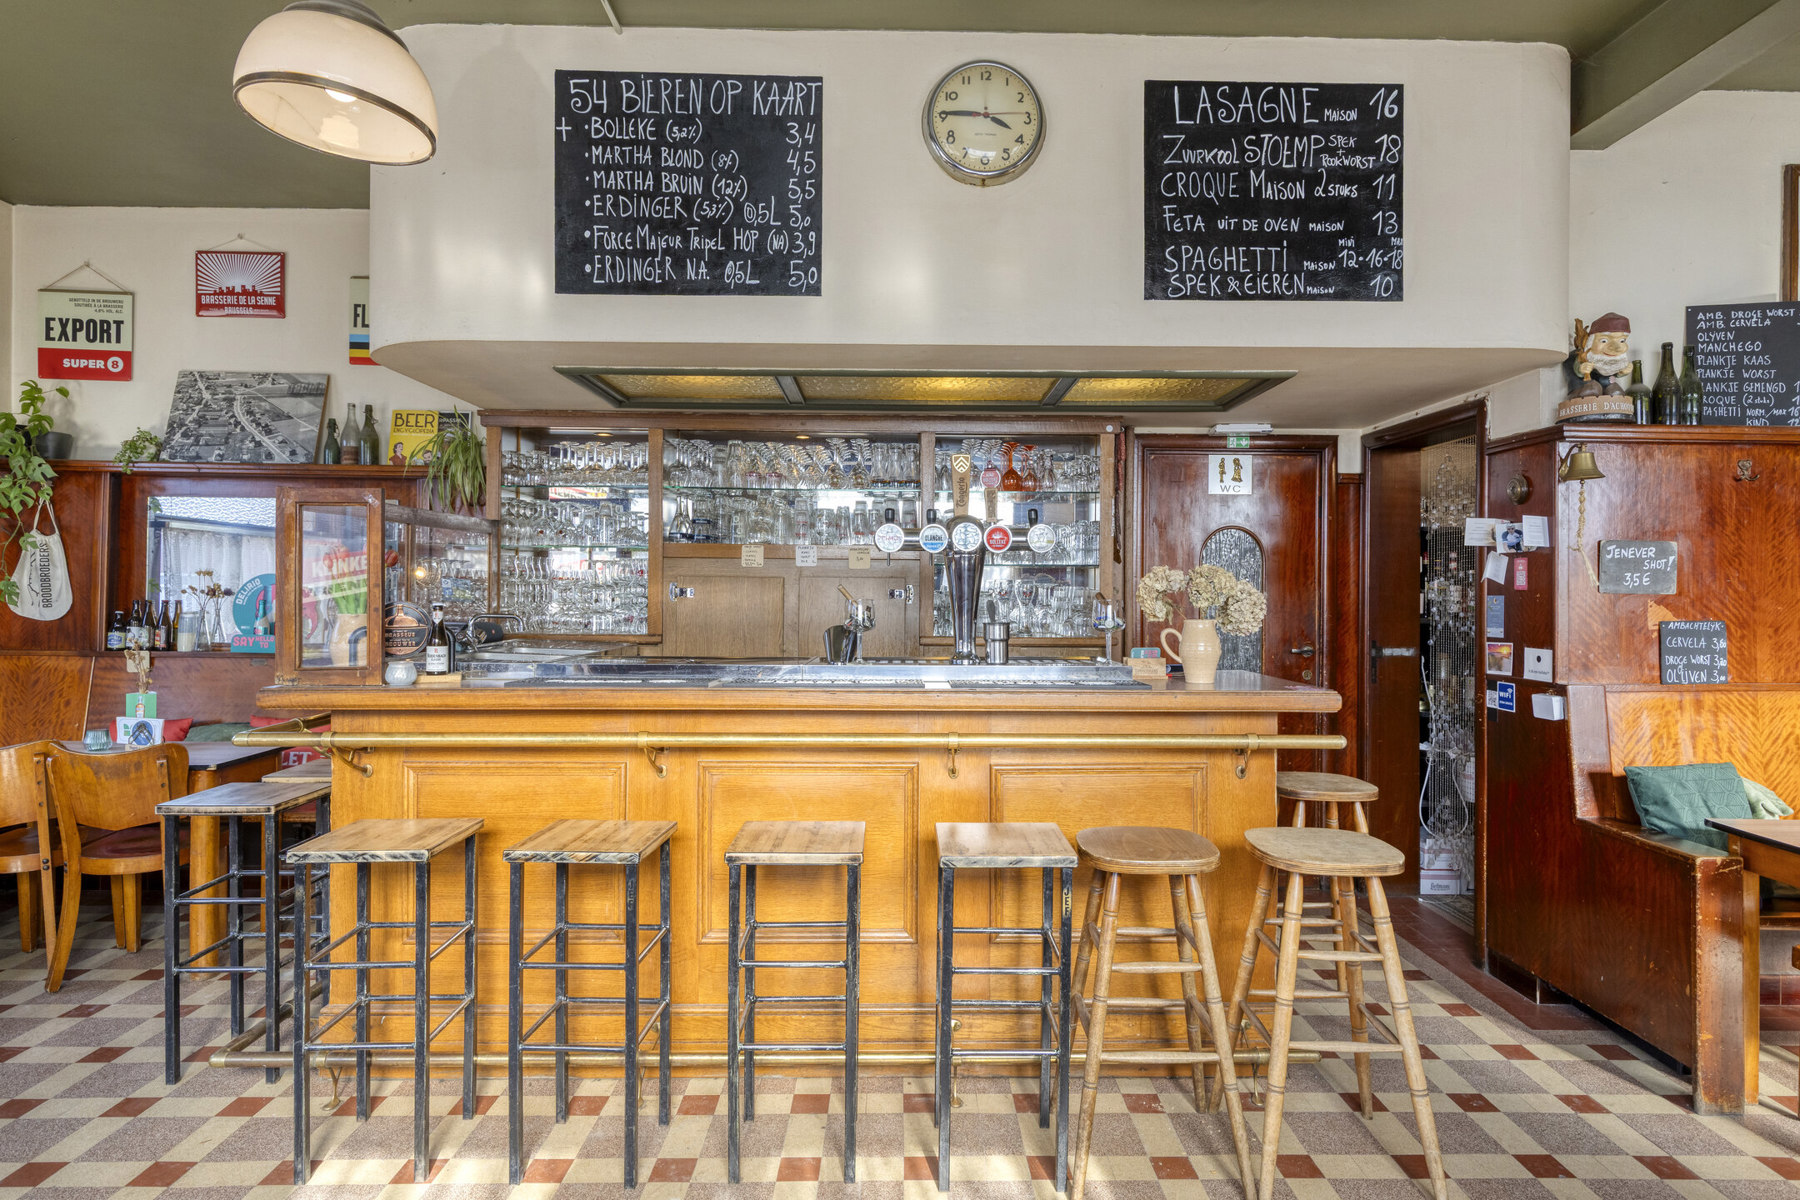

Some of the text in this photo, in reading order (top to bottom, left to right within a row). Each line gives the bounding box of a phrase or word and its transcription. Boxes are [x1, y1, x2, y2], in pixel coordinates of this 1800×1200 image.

[962, 75, 971, 85] 11
[980, 70, 992, 81] 12
[569, 75, 822, 116] 54 BIEREN OP KAART
[945, 91, 958, 101] 10
[1017, 92, 1025, 103] 2
[1174, 85, 1399, 124] LASAGNE MAISON 16
[1023, 111, 1032, 125] 3
[591, 117, 656, 140] BOLLEKE
[666, 118, 702, 144] (5,2%)
[786, 122, 815, 147] 3,4
[945, 129, 956, 145] 8
[1014, 134, 1025, 145] 4
[1001, 148, 1011, 161] 5
[1244, 134, 1325, 167] STOEMP
[1328, 135, 1357, 148] SPEK
[1375, 134, 1401, 163] 18
[592, 145, 815, 175] MARTHA BLOND (8%) 4,5
[1320, 154, 1376, 168] ROOKWORST
[594, 171, 815, 202] MARTHA BRUIN (12%) 5,5
[1160, 172, 1239, 205] CROQUE
[1314, 168, 1326, 197] 2
[1372, 174, 1396, 200] 11
[593, 194, 811, 229] ERDINGER (5,3%) 0,5L 5,0
[1163, 205, 1205, 232] FETA
[1243, 219, 1258, 231] DE
[1264, 217, 1300, 232] OVEN
[1309, 220, 1344, 231] MAISON
[1372, 210, 1398, 236] 13
[594, 225, 633, 249] FORCE
[734, 230, 758, 253] HOP
[768, 231, 788, 254] (NA)
[794, 231, 815, 258] 3,9
[1164, 240, 1287, 272] SPAGHETTI
[1303, 261, 1335, 271] MAISON
[593, 256, 676, 283] ERDINGER
[725, 260, 759, 289] 0,5L
[789, 261, 817, 292] 5,0
[1167, 273, 1221, 297] SPEK
[1244, 272, 1305, 295] EIEREN
[1370, 275, 1393, 297] 10
[201, 295, 277, 306] BRASSERIE DE LA SENNE
[1697, 311, 1726, 320] AMB.
[1766, 308, 1795, 317] WORST
[45, 317, 124, 344] EXPORT
[1696, 319, 1771, 329] AMB. CERVELA
[1698, 341, 1762, 352] MANCHEGO
[63, 358, 105, 369] SUPER
[1696, 355, 1771, 369] PLANKJE KAAS
[1696, 369, 1776, 379] PLANKJE WORST
[1743, 382, 1786, 393] GEMENGD
[1702, 396, 1736, 406] ROQUE
[1703, 405, 1741, 417] PAGHETTI
[394, 413, 435, 428] BEER
[1220, 485, 1241, 493] WC
[1605, 545, 1656, 558] JENEVER
[1643, 556, 1675, 571] SHOT!
[39, 543, 53, 608] BROODBROEDERS
[235, 578, 261, 605] DELIRIO
[233, 636, 255, 647] SAY
[1666, 636, 1707, 649] CERVELA
[1690, 654, 1711, 666] WORST
